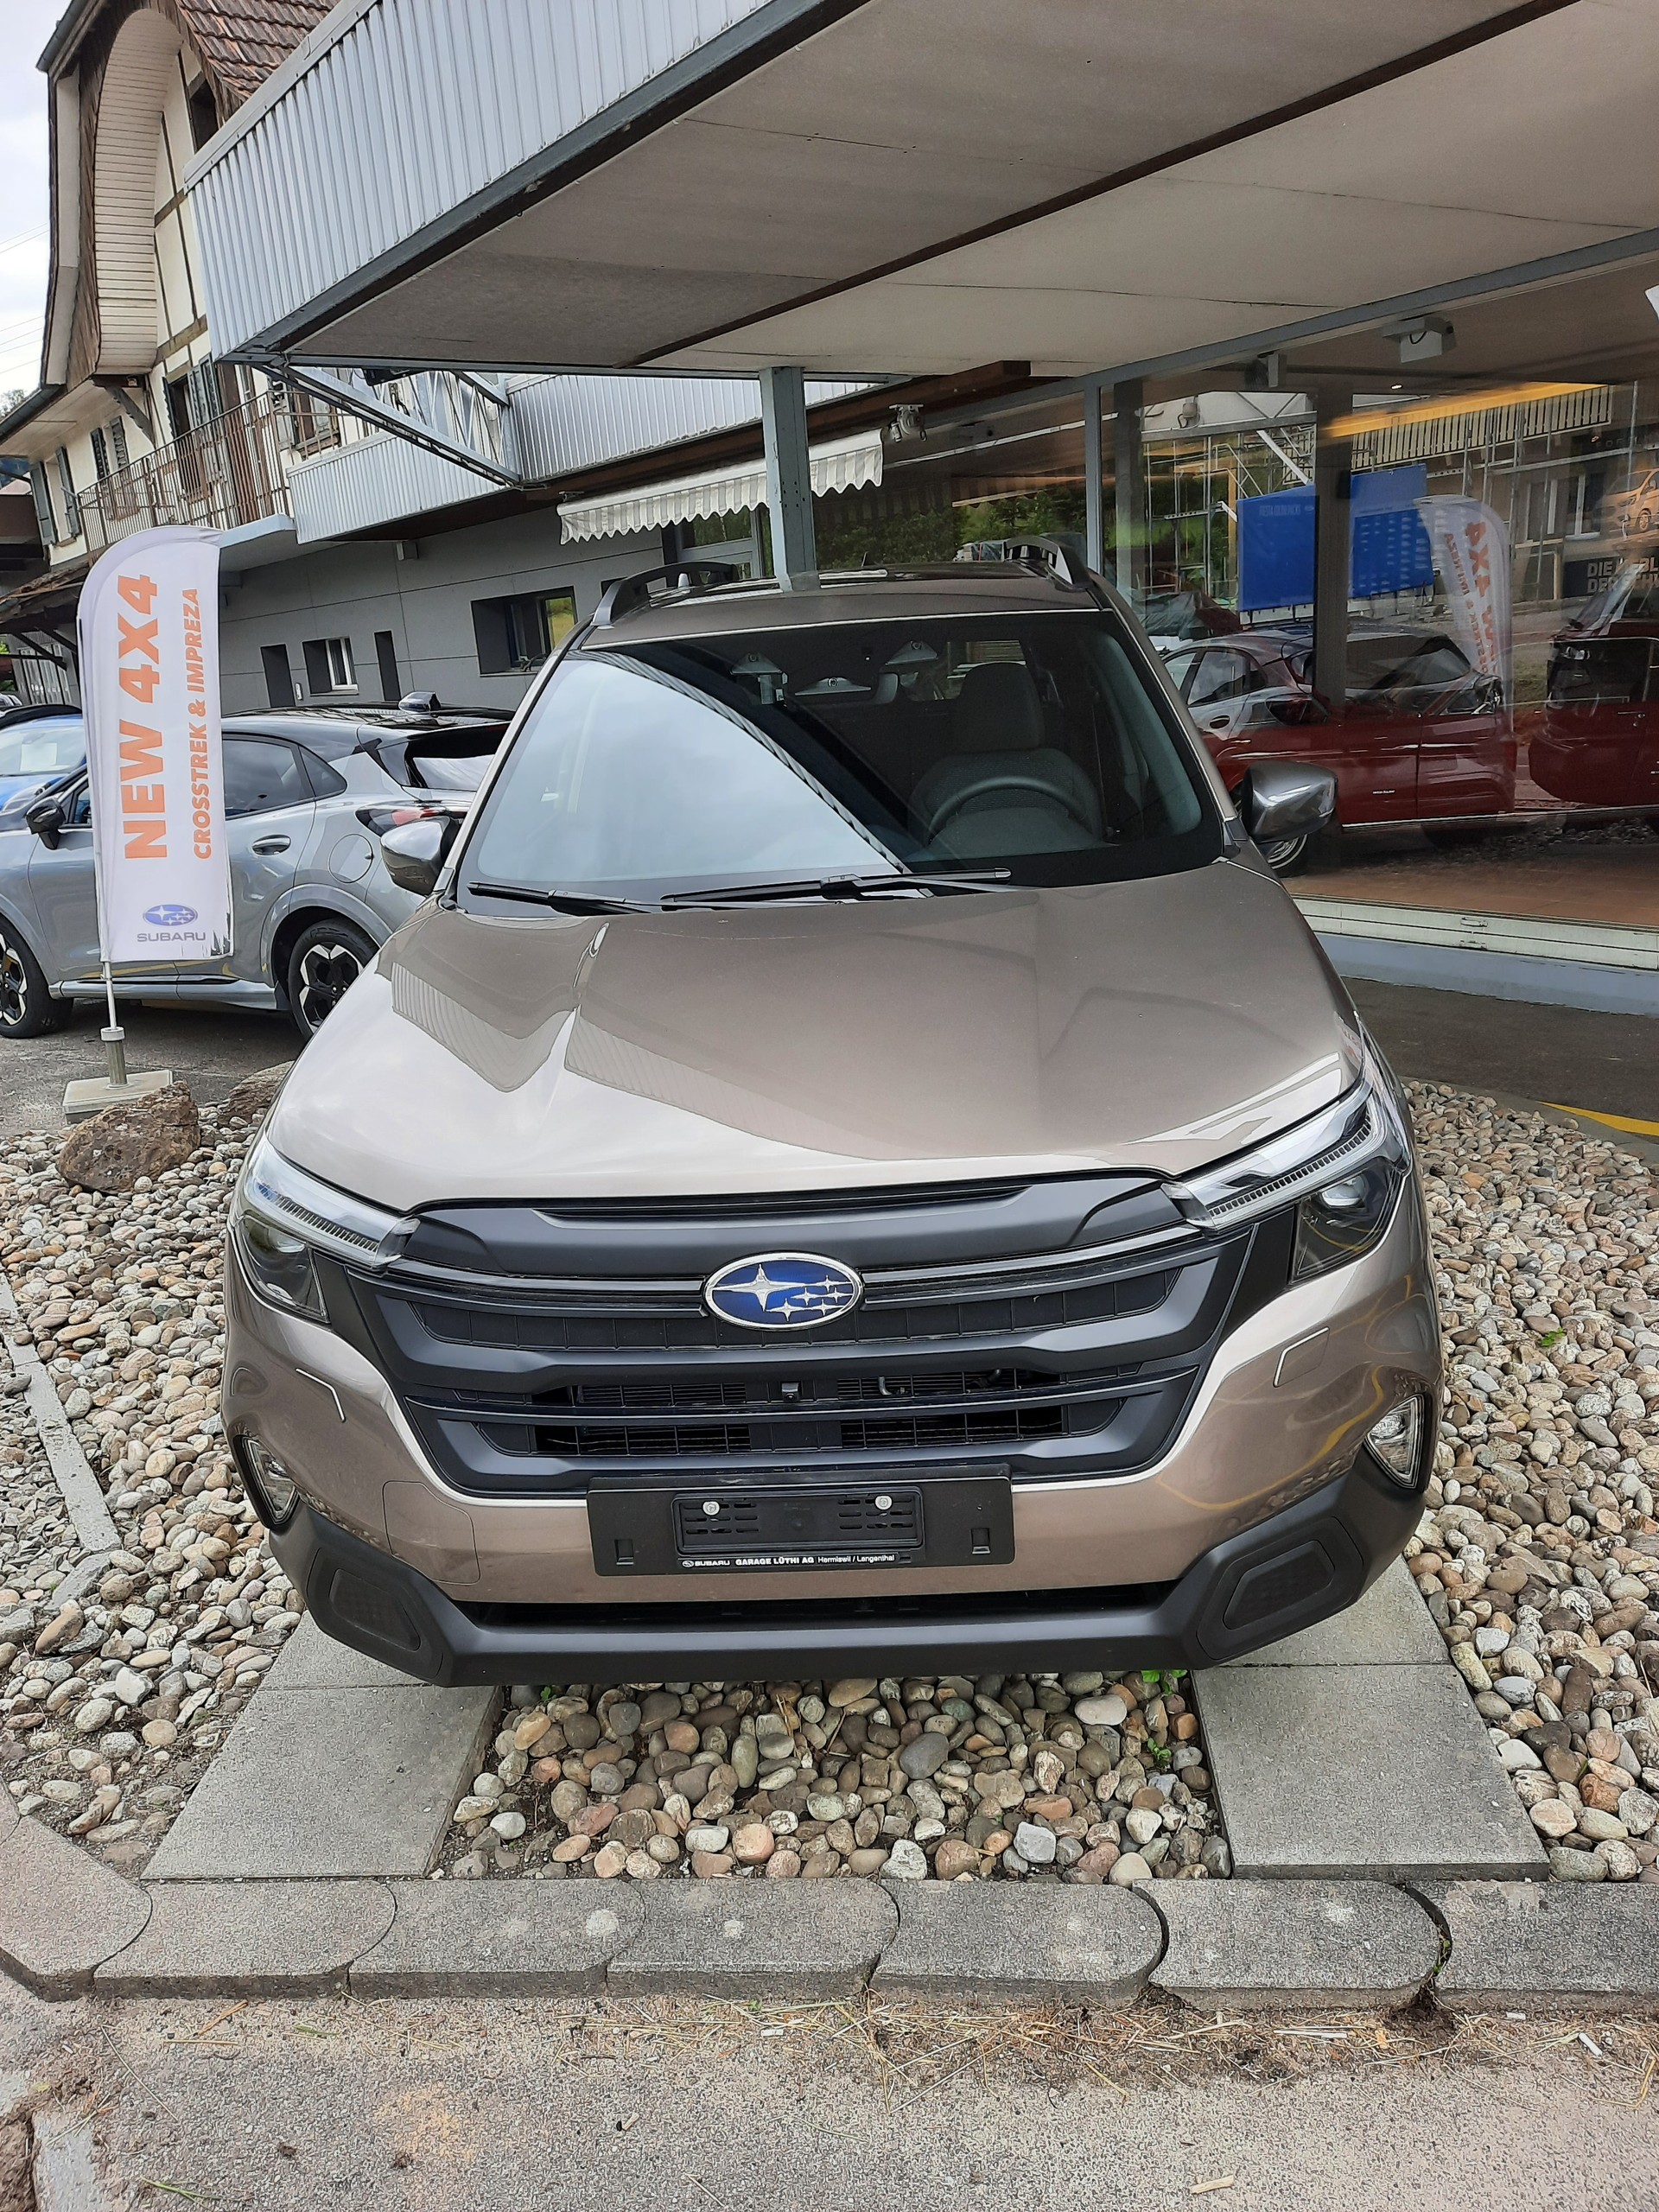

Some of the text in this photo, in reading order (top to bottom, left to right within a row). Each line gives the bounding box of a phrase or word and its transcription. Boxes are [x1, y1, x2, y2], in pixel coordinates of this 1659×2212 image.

[1587, 561, 1613, 577] DIE
[118, 575, 168, 859] NEW 4X4
[182, 588, 212, 859] CROSSTREK & IMPREZA
[137, 931, 207, 942] SUBARU
[773, 1556, 799, 1565] LÜTHI
[856, 1554, 895, 1563] Langenthal
